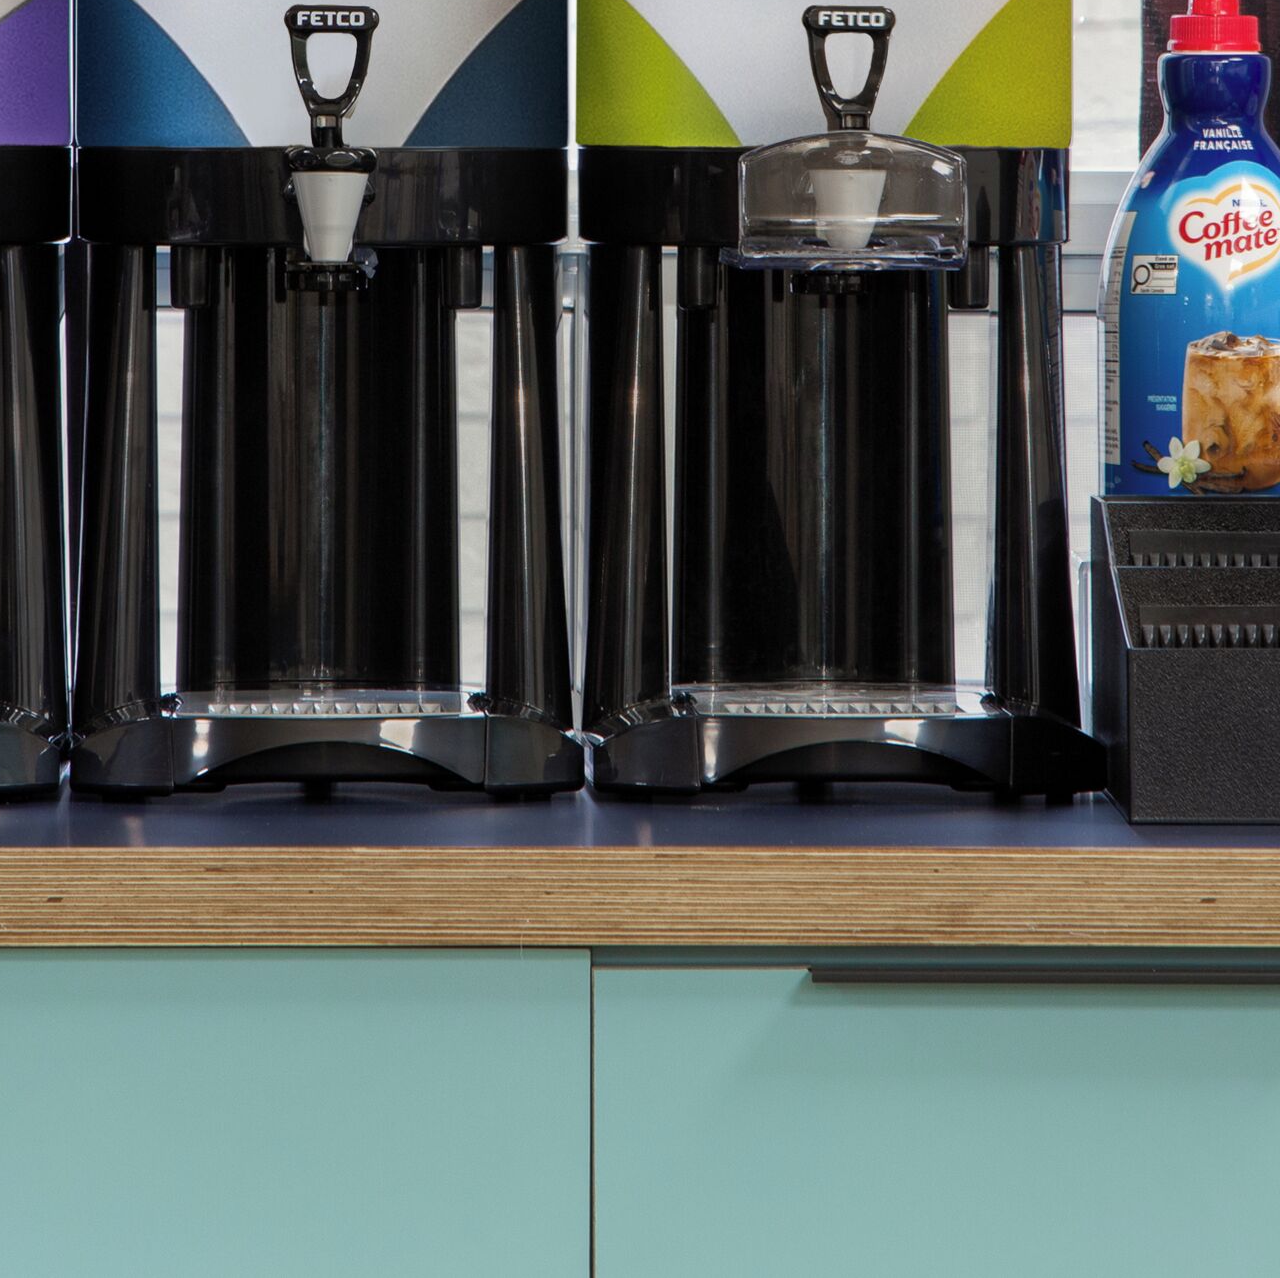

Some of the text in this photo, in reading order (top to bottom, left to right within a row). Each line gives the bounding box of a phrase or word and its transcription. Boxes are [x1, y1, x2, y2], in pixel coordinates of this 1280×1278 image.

[297, 10, 365, 27] FETCO
[818, 10, 886, 27] FETCO
[1202, 128, 1244, 139] VANILLE
[1193, 140, 1255, 153] FRANÇAISE
[1204, 228, 1279, 261] mate
